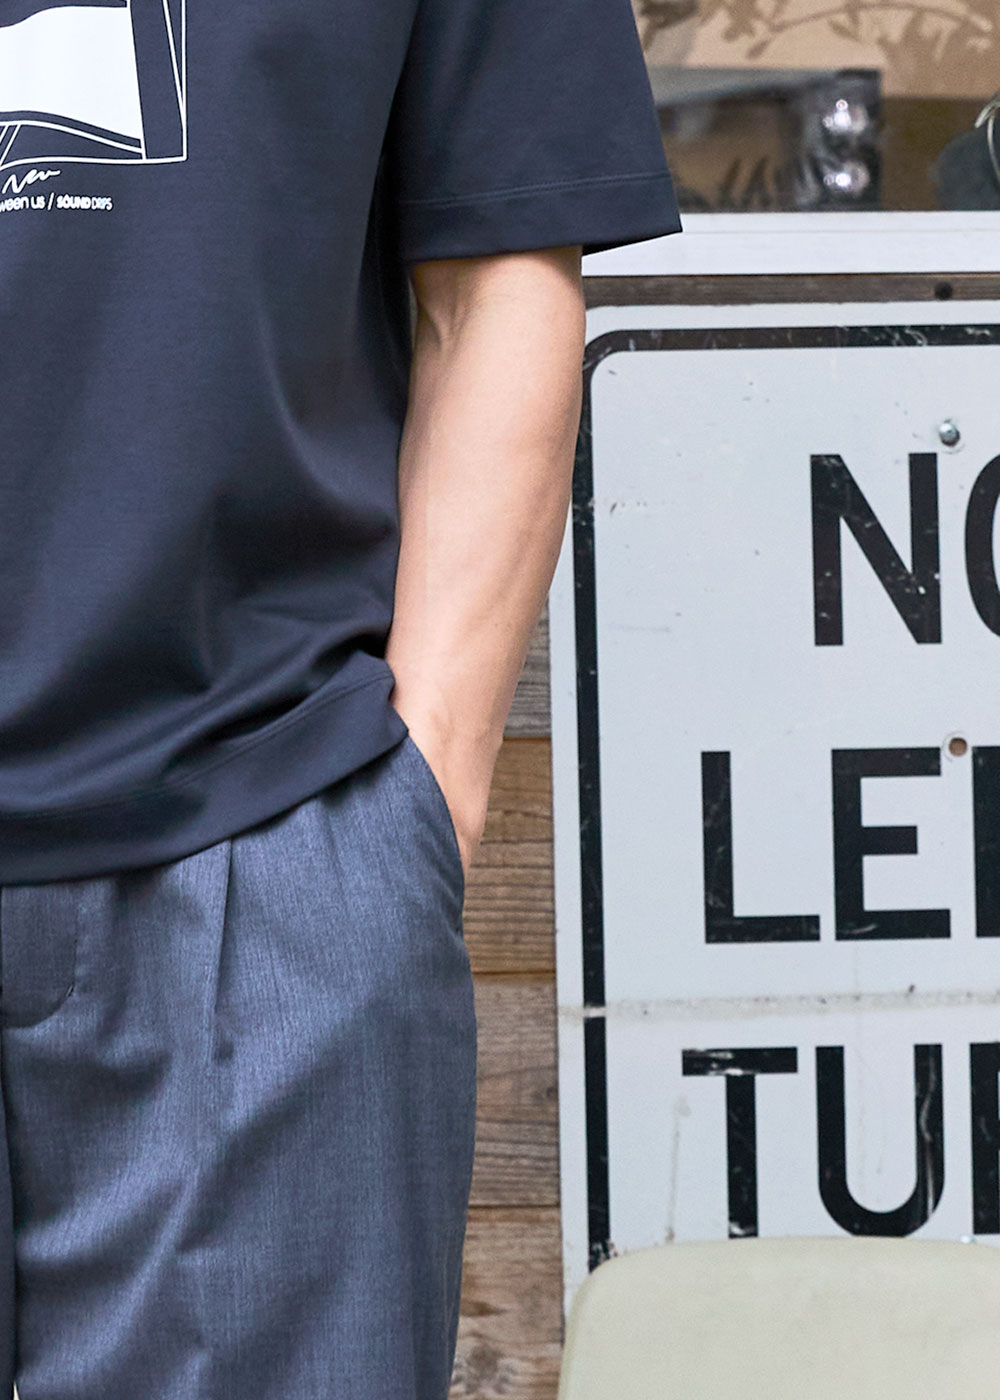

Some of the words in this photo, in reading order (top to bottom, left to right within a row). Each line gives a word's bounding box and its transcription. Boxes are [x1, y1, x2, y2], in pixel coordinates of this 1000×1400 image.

[30, 196, 46, 210] us
[56, 194, 91, 210] SOUND
[810, 452, 1000, 646] N
[701, 745, 1000, 943] LE
[682, 1042, 1000, 1239] TU
